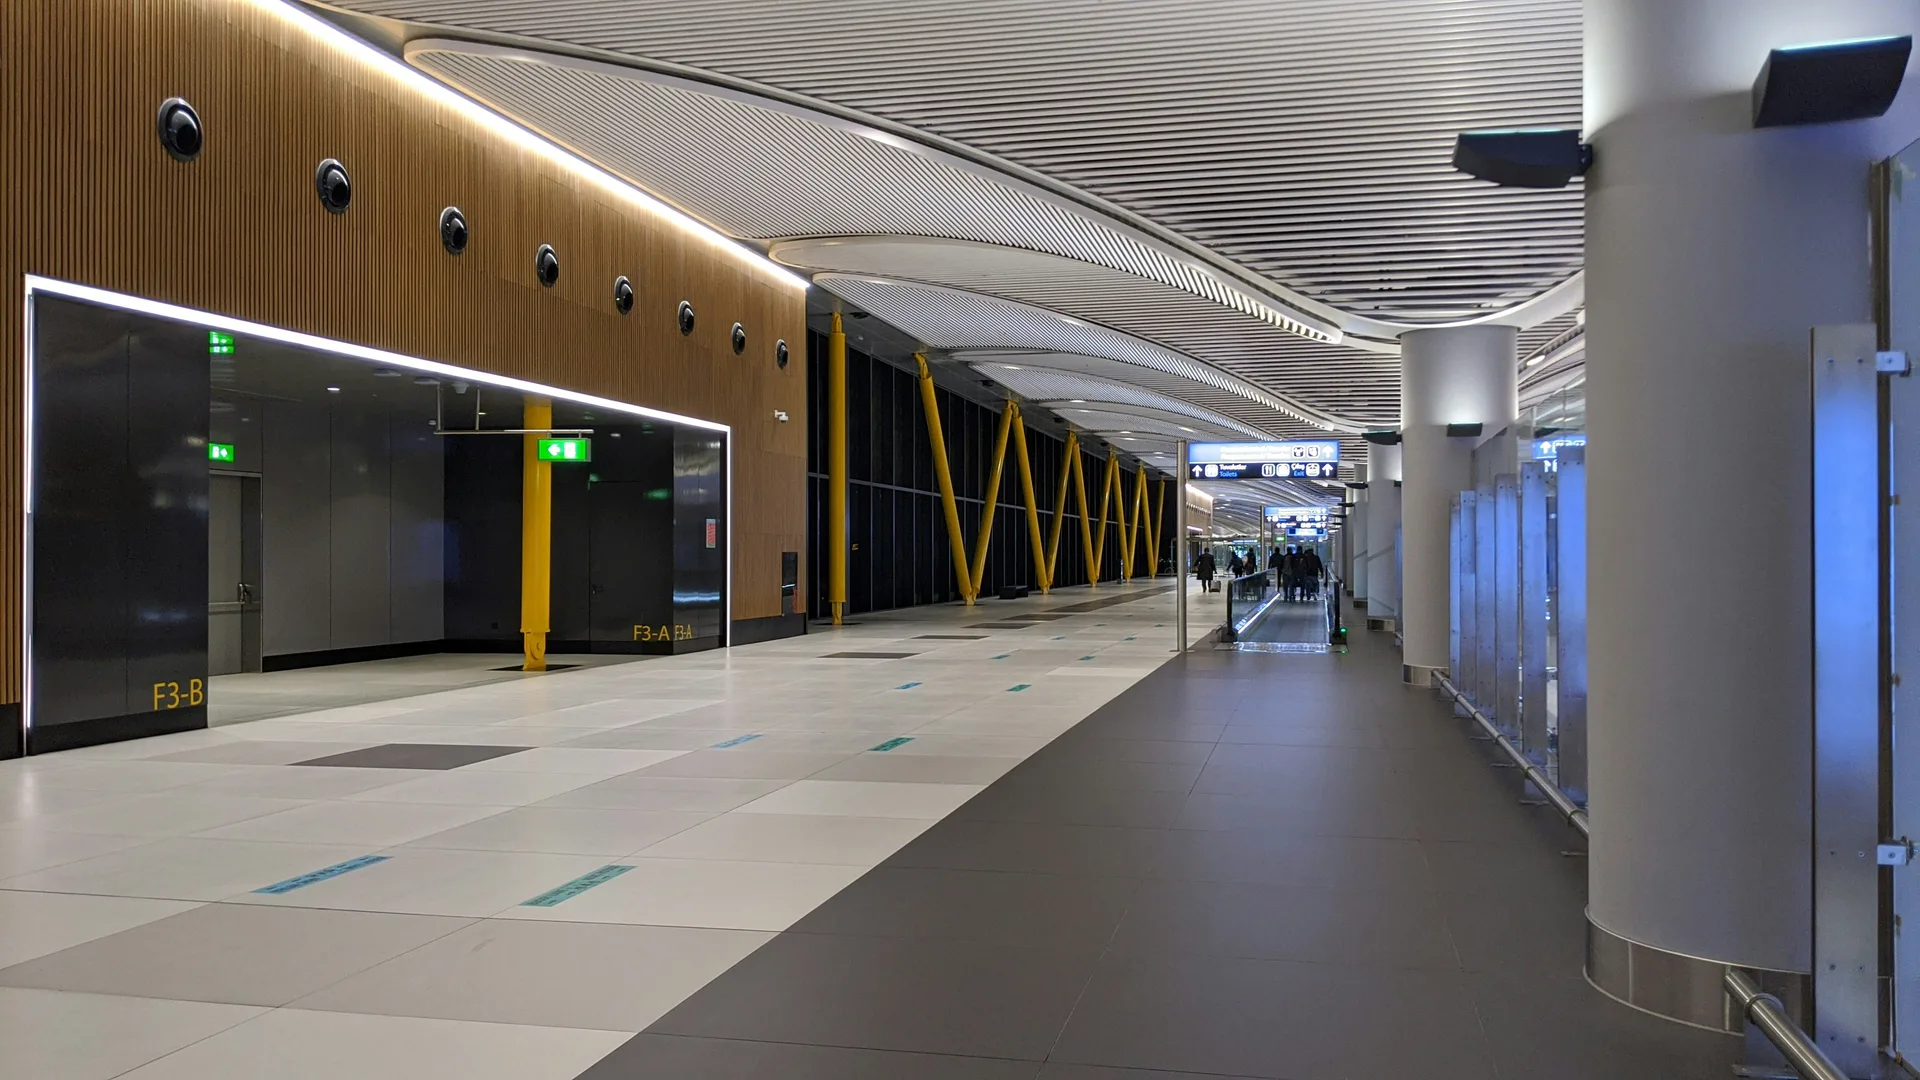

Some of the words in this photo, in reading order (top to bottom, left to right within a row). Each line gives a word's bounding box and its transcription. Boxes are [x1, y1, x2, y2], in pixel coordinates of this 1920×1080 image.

[633, 625, 670, 641] F3-A
[675, 624, 692, 640] F3-A
[153, 678, 204, 711] F3-B
